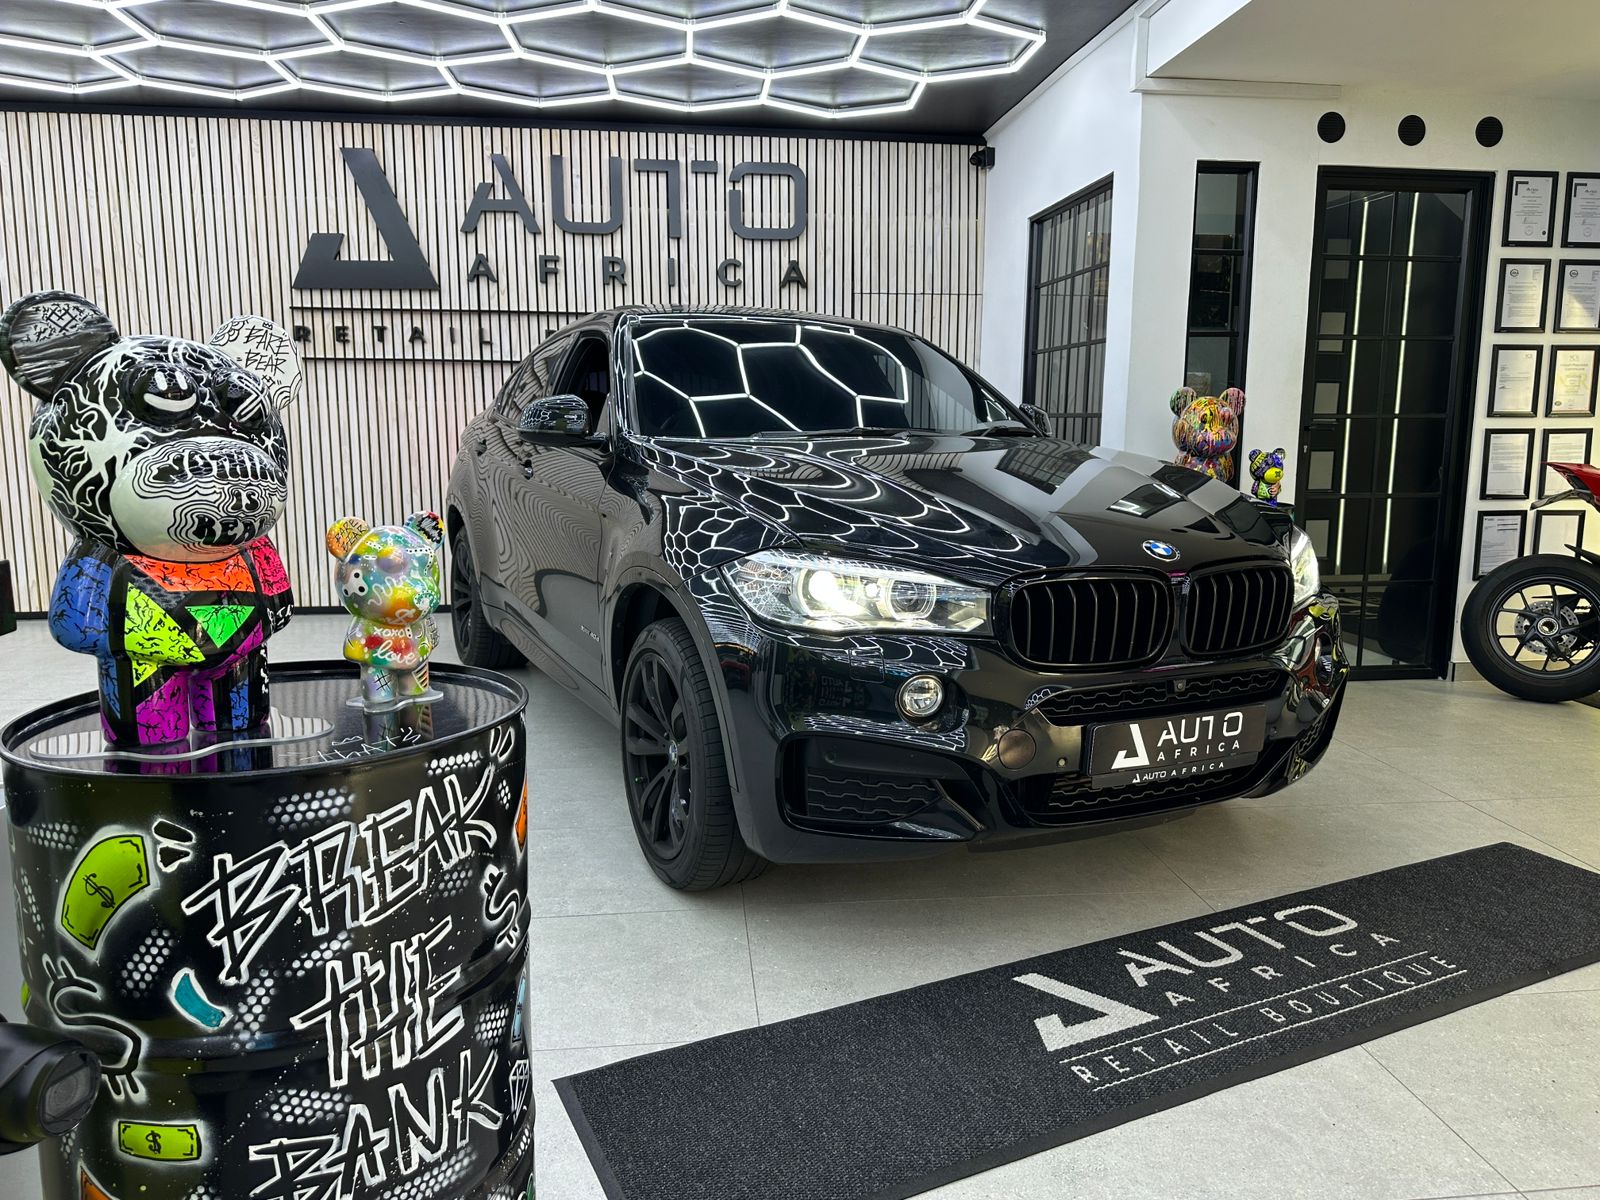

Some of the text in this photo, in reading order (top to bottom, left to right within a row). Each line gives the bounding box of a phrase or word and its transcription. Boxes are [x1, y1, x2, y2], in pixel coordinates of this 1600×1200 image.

[460, 153, 808, 241] AUTO
[467, 253, 807, 289] AFRICA
[243, 325, 290, 356] BARE
[294, 324, 493, 345] RETAIL
[244, 349, 287, 376] BEAR
[373, 639, 417, 665] love
[1157, 711, 1244, 747] AUTO
[1157, 739, 1240, 762] AFRICA
[1142, 761, 1225, 781] AUTO AFRICA
[181, 763, 498, 986] BREAK
[1117, 904, 1358, 988] AUTO
[1165, 932, 1400, 1007] AFRICA
[289, 915, 466, 1088] THE
[1071, 955, 1457, 1084] RETAIL BOUTIQUE
